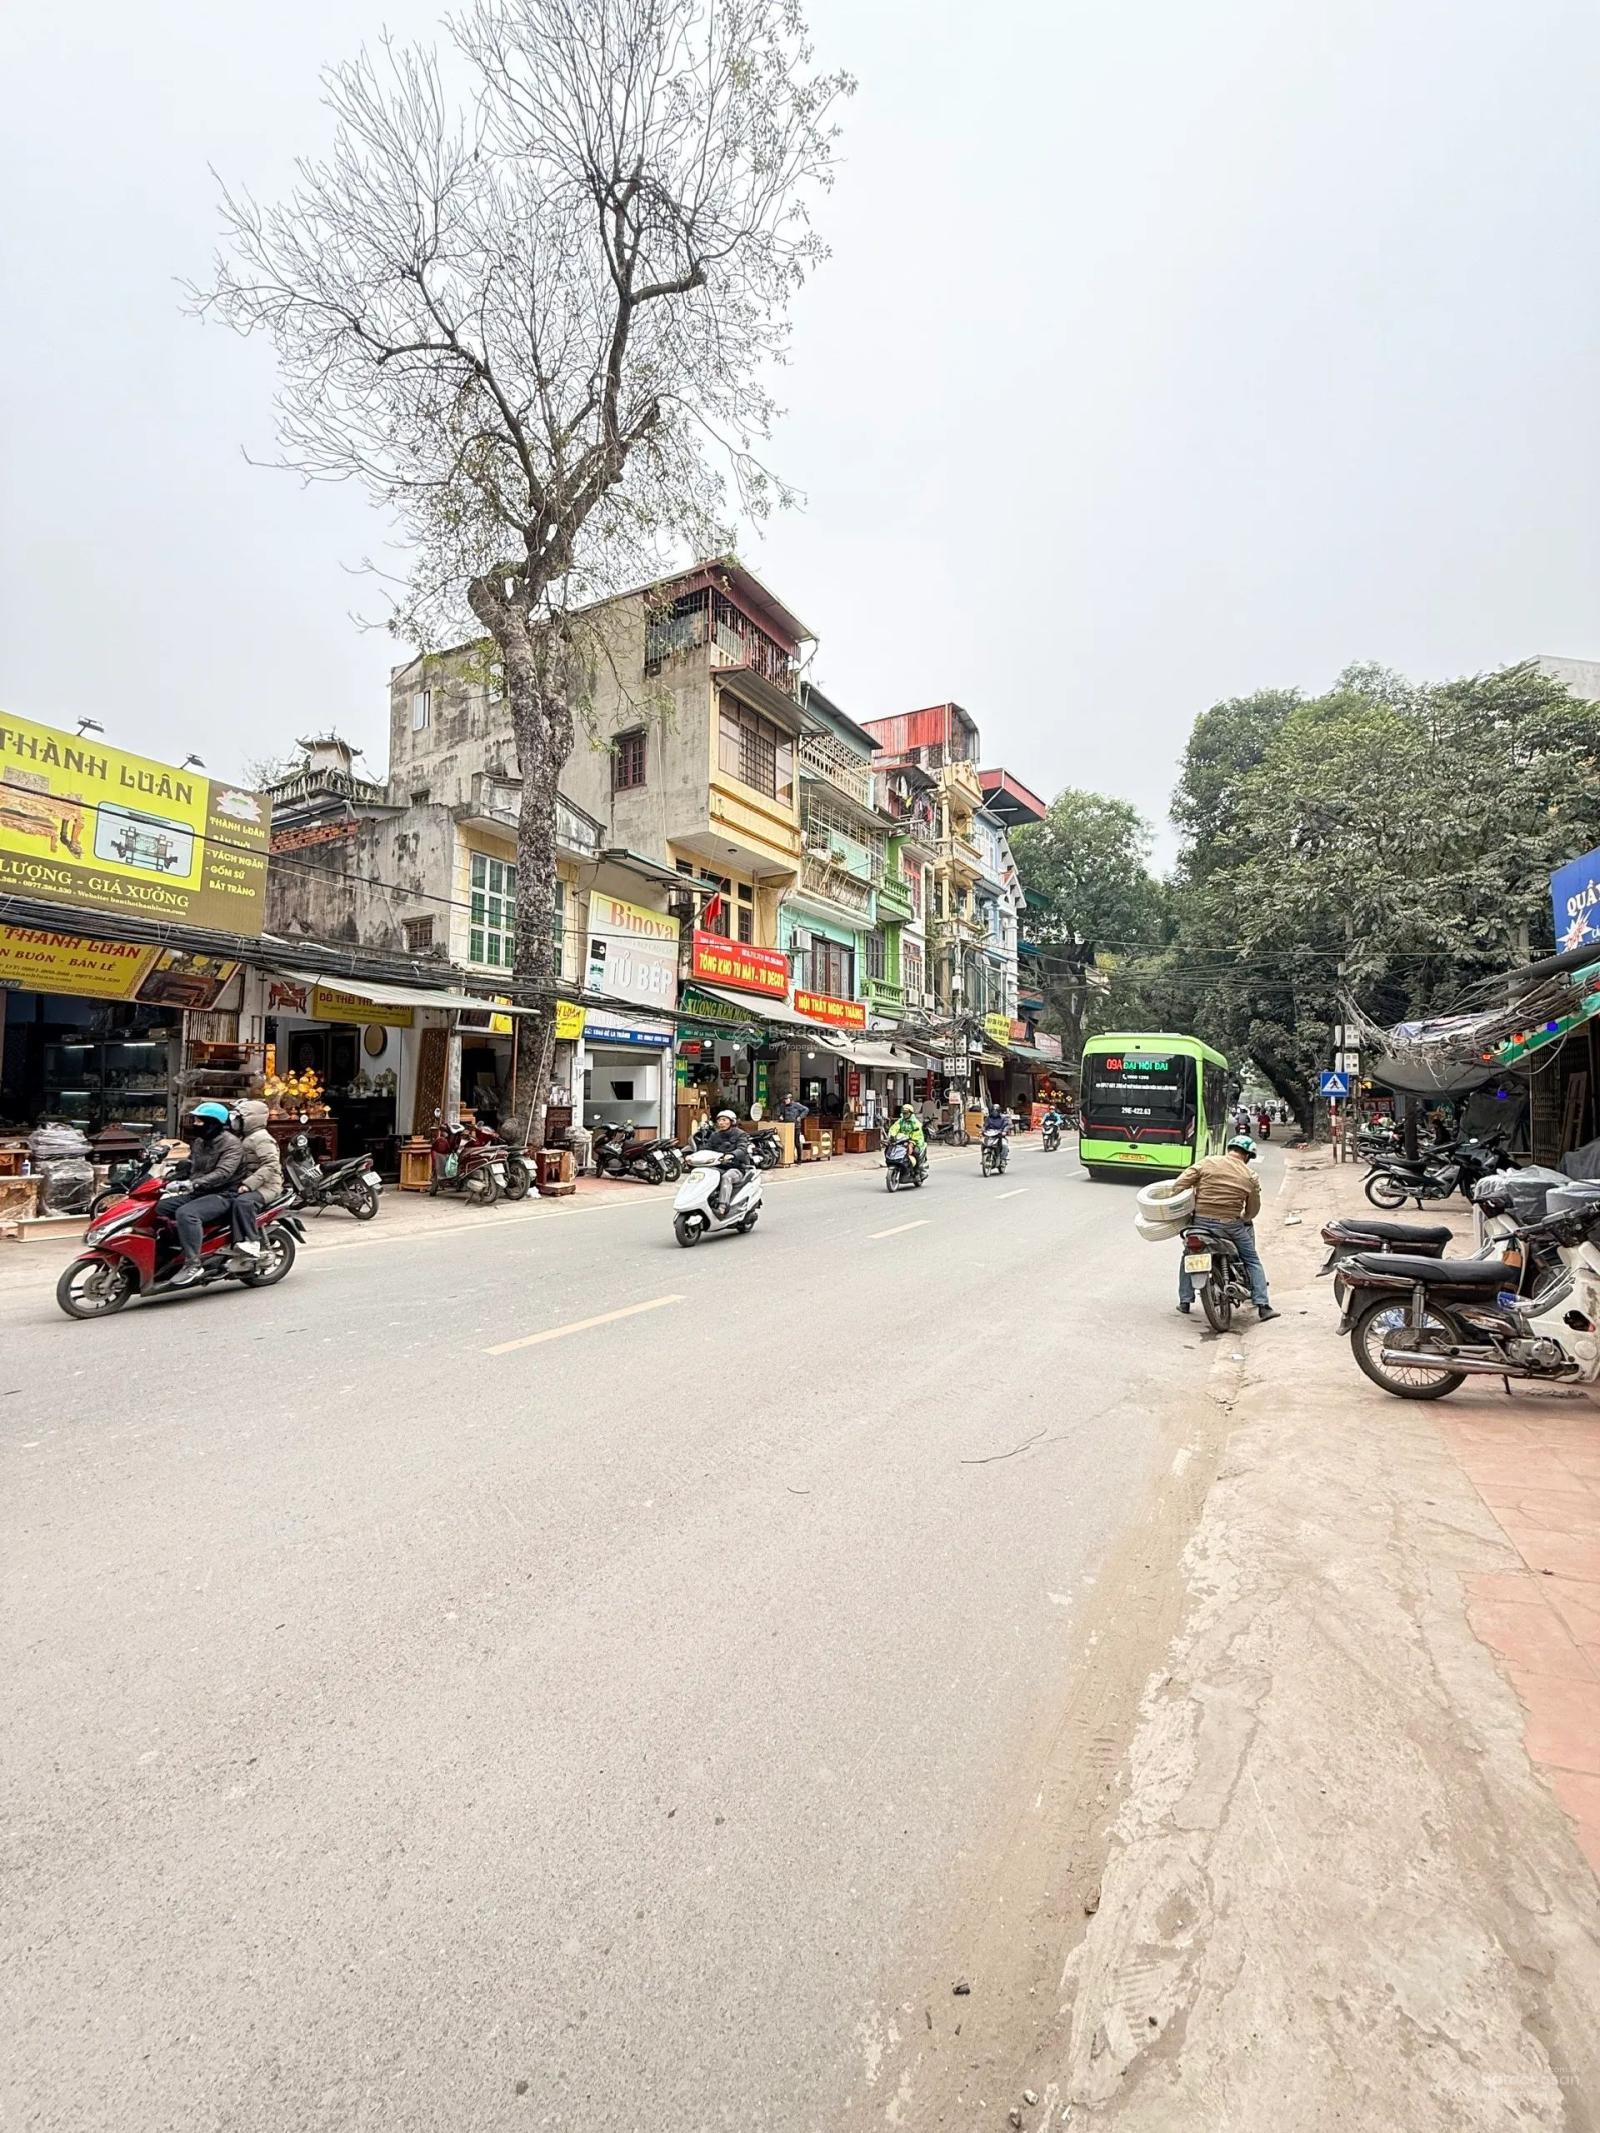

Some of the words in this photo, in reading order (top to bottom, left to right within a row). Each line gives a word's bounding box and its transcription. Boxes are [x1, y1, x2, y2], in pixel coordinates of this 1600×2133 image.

[0, 727, 108, 780] THÀNH
[120, 765, 193, 805] LUÂN
[0, 858, 72, 885] LƯỢNG
[88, 878, 122, 895] GIÁ
[126, 883, 190, 908] XƯỞNG
[608, 901, 674, 940] Binova
